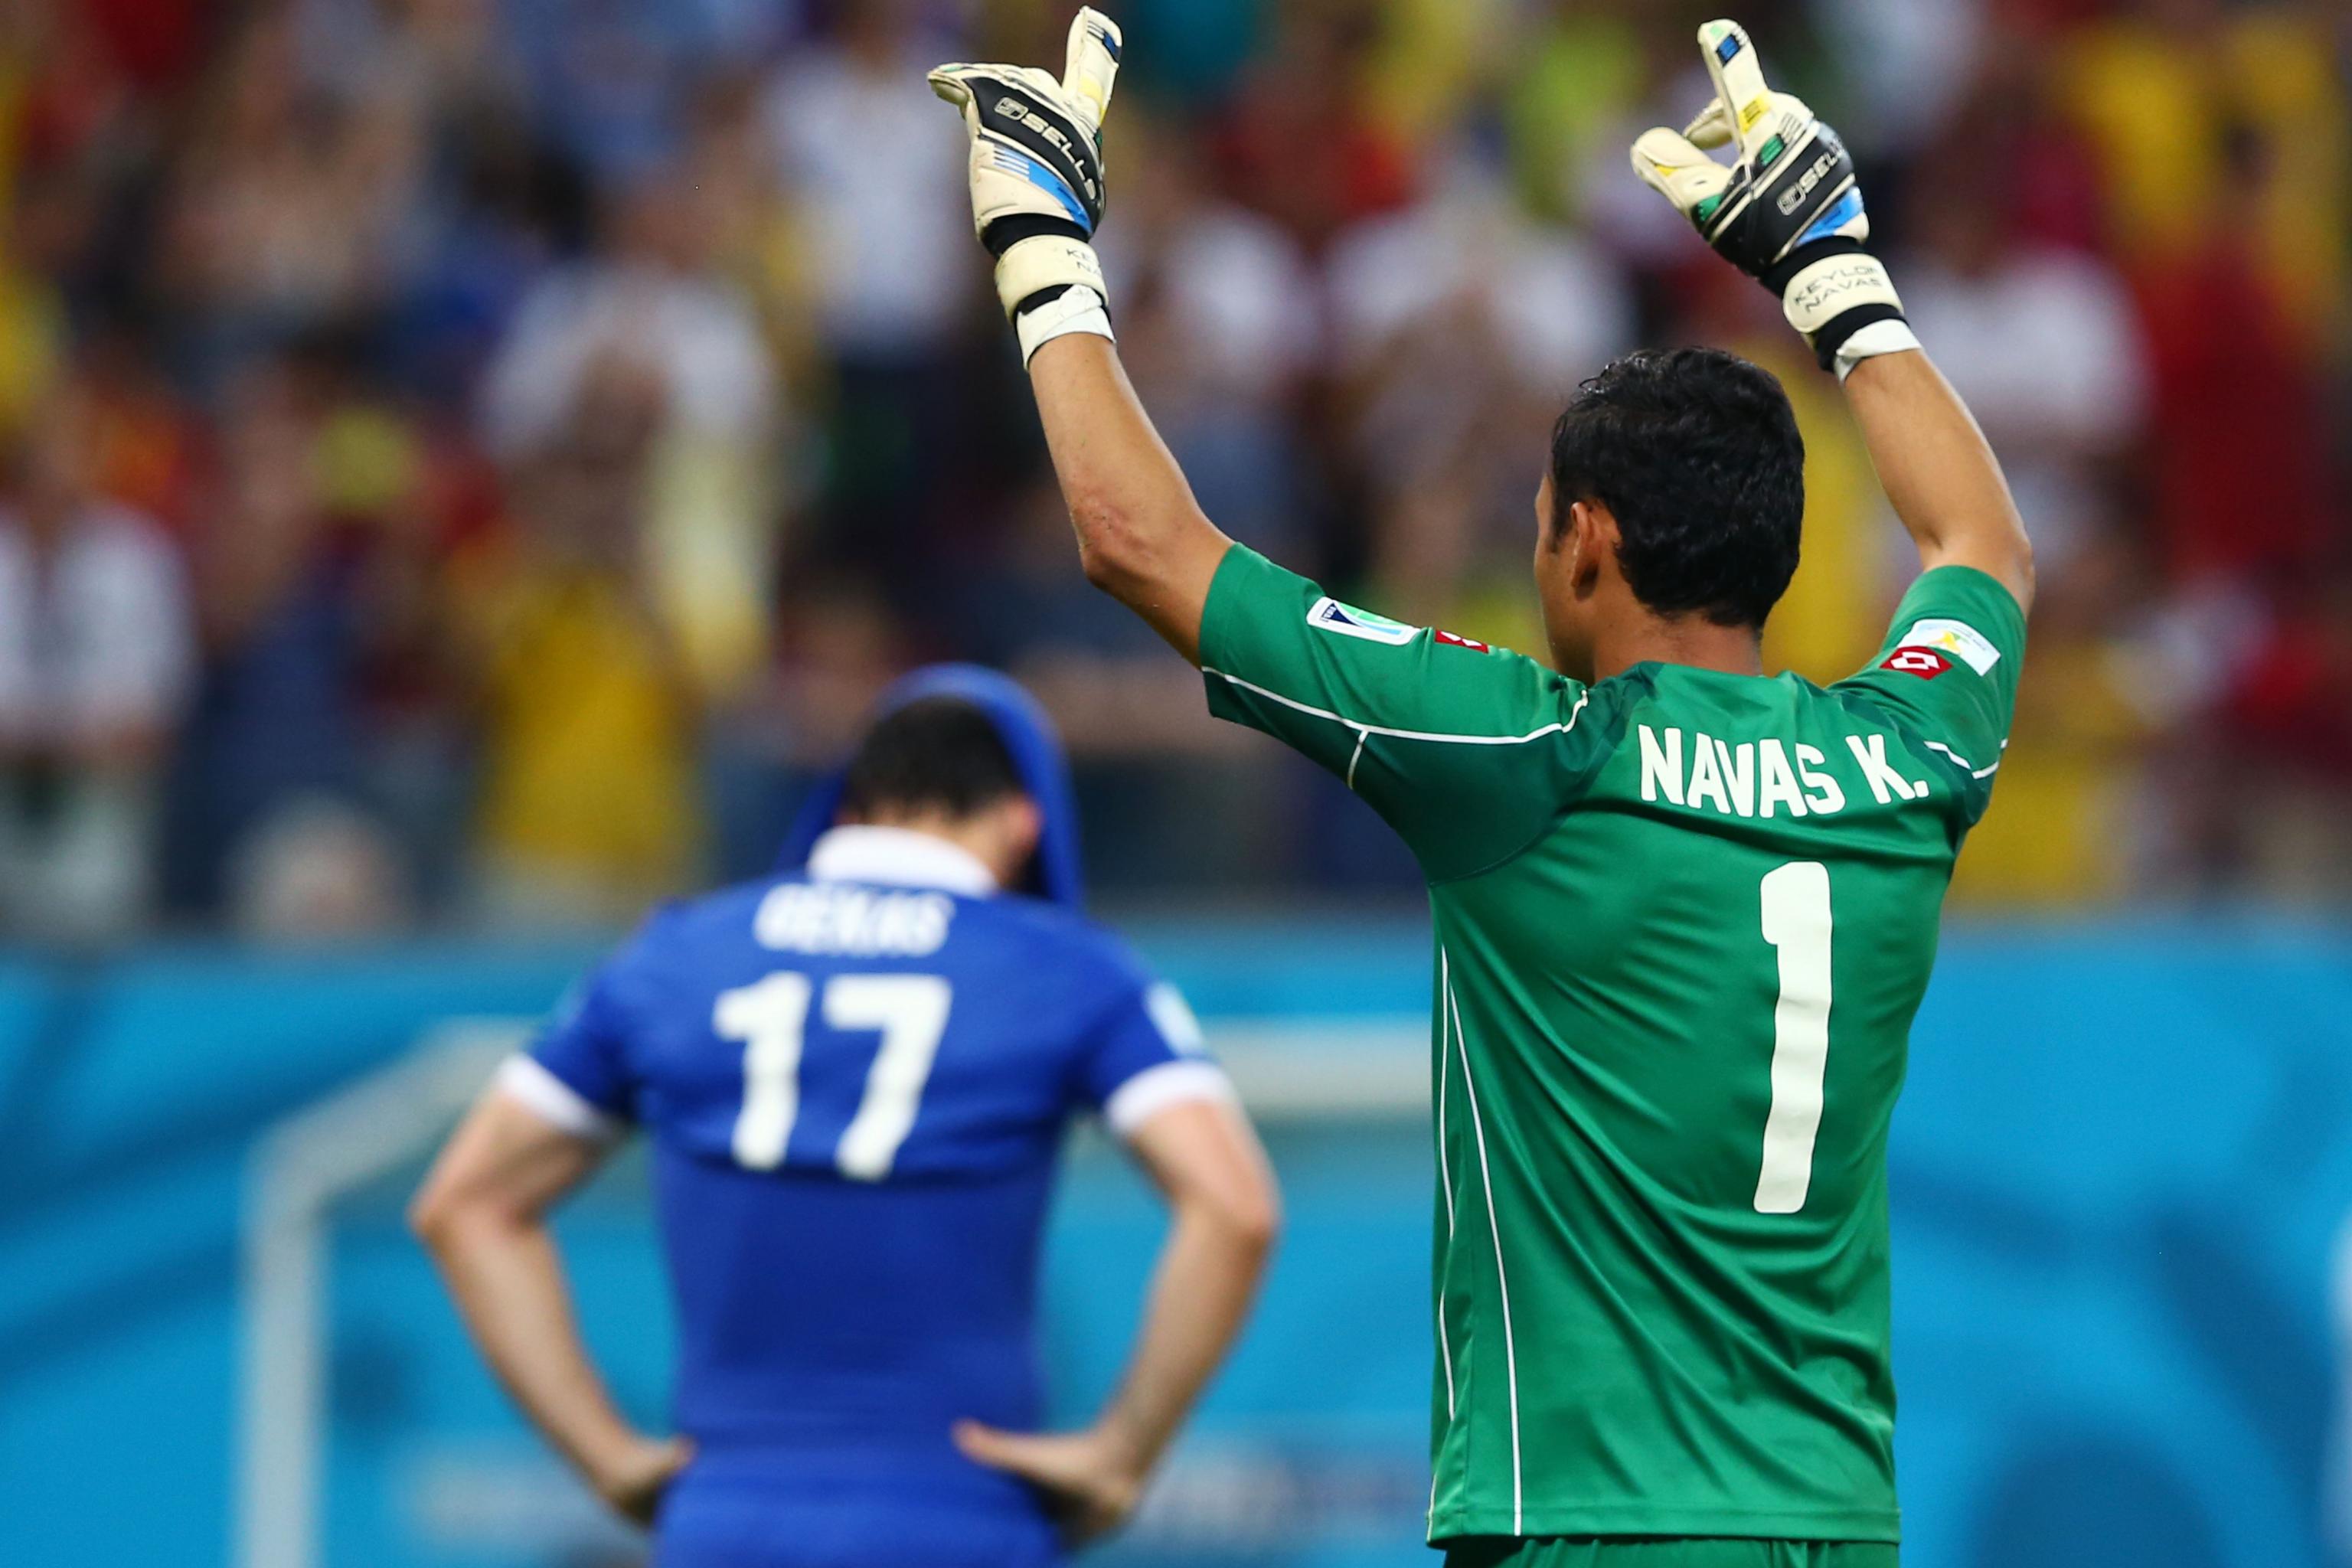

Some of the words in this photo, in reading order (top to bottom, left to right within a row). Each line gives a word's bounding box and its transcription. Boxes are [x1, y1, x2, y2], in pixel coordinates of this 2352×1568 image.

[1805, 279, 1882, 312] NAVAS
[1638, 724, 1846, 818] NAVAS
[1845, 733, 1930, 805] K.
[713, 970, 952, 1183] 17
[1753, 861, 1834, 1214] 1
